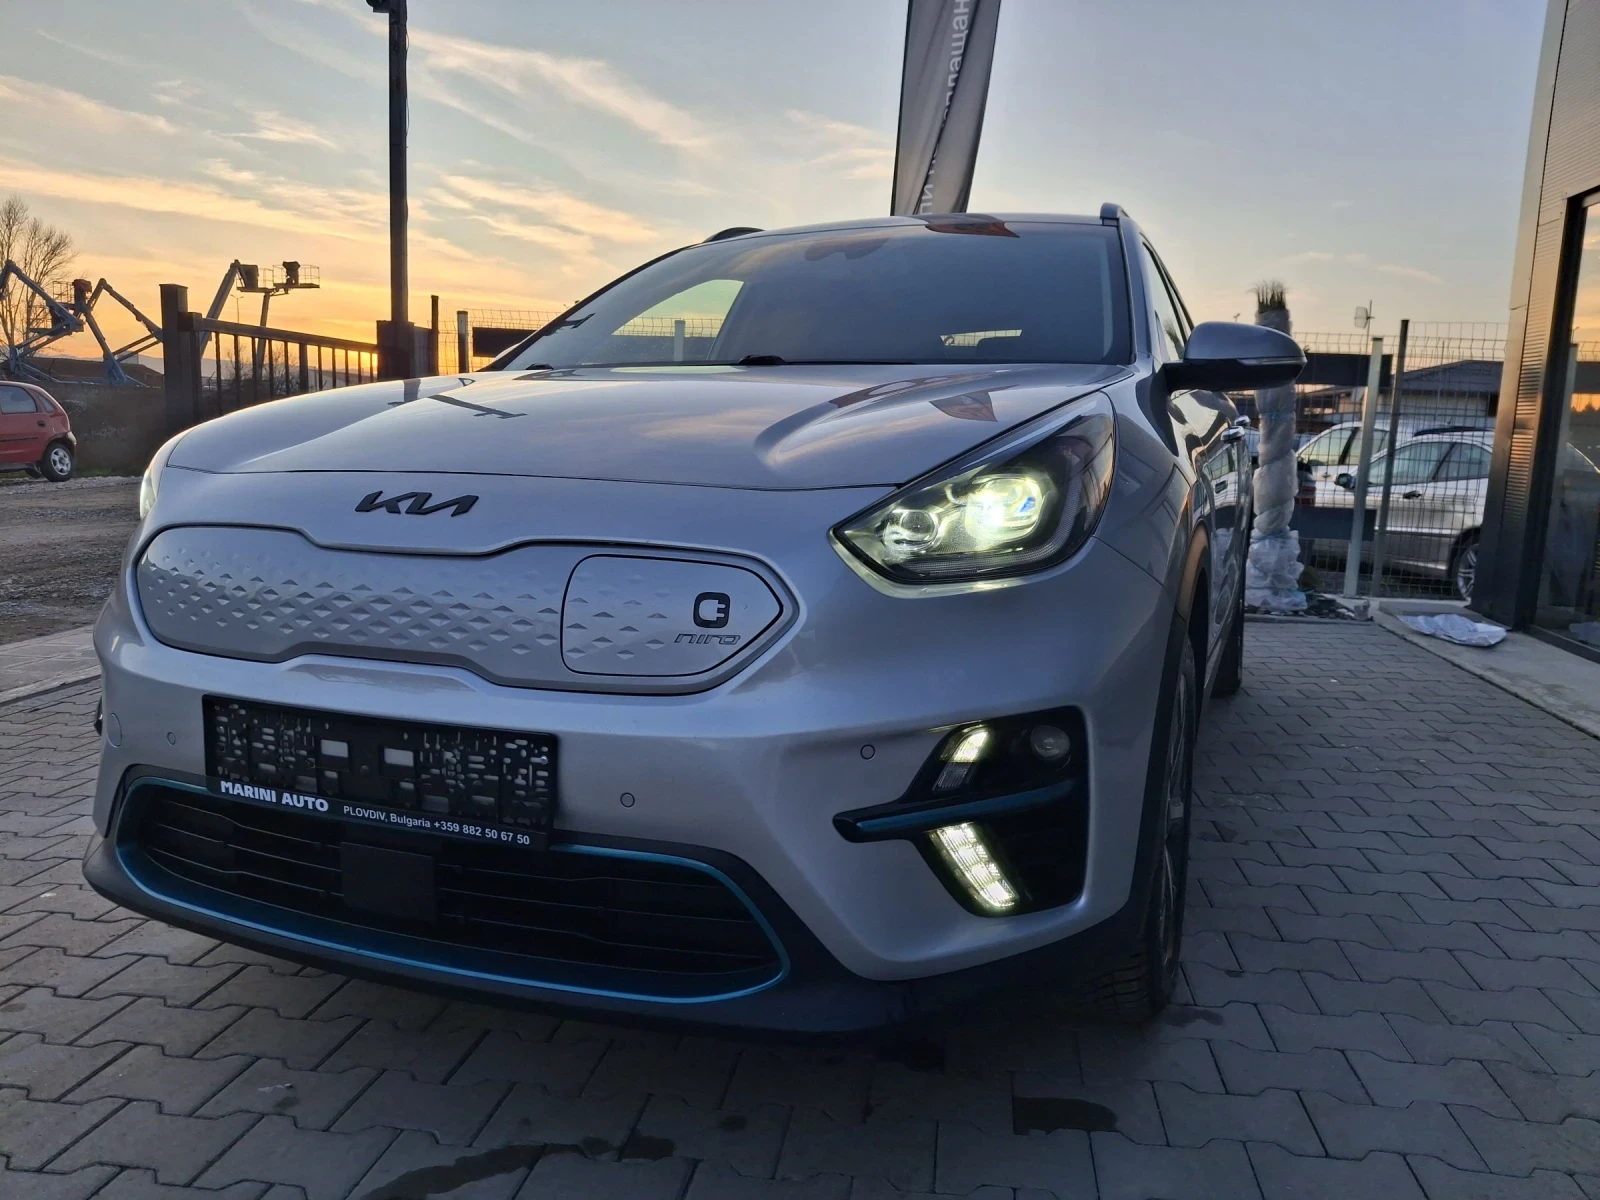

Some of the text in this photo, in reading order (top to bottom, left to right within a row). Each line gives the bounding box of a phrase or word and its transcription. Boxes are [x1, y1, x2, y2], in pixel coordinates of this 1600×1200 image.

[354, 490, 480, 518] KIA
[220, 780, 329, 812] MARINI AUTO
[343, 805, 530, 845] PLOVDIV, Bulgaria +359 882 50 67 50
